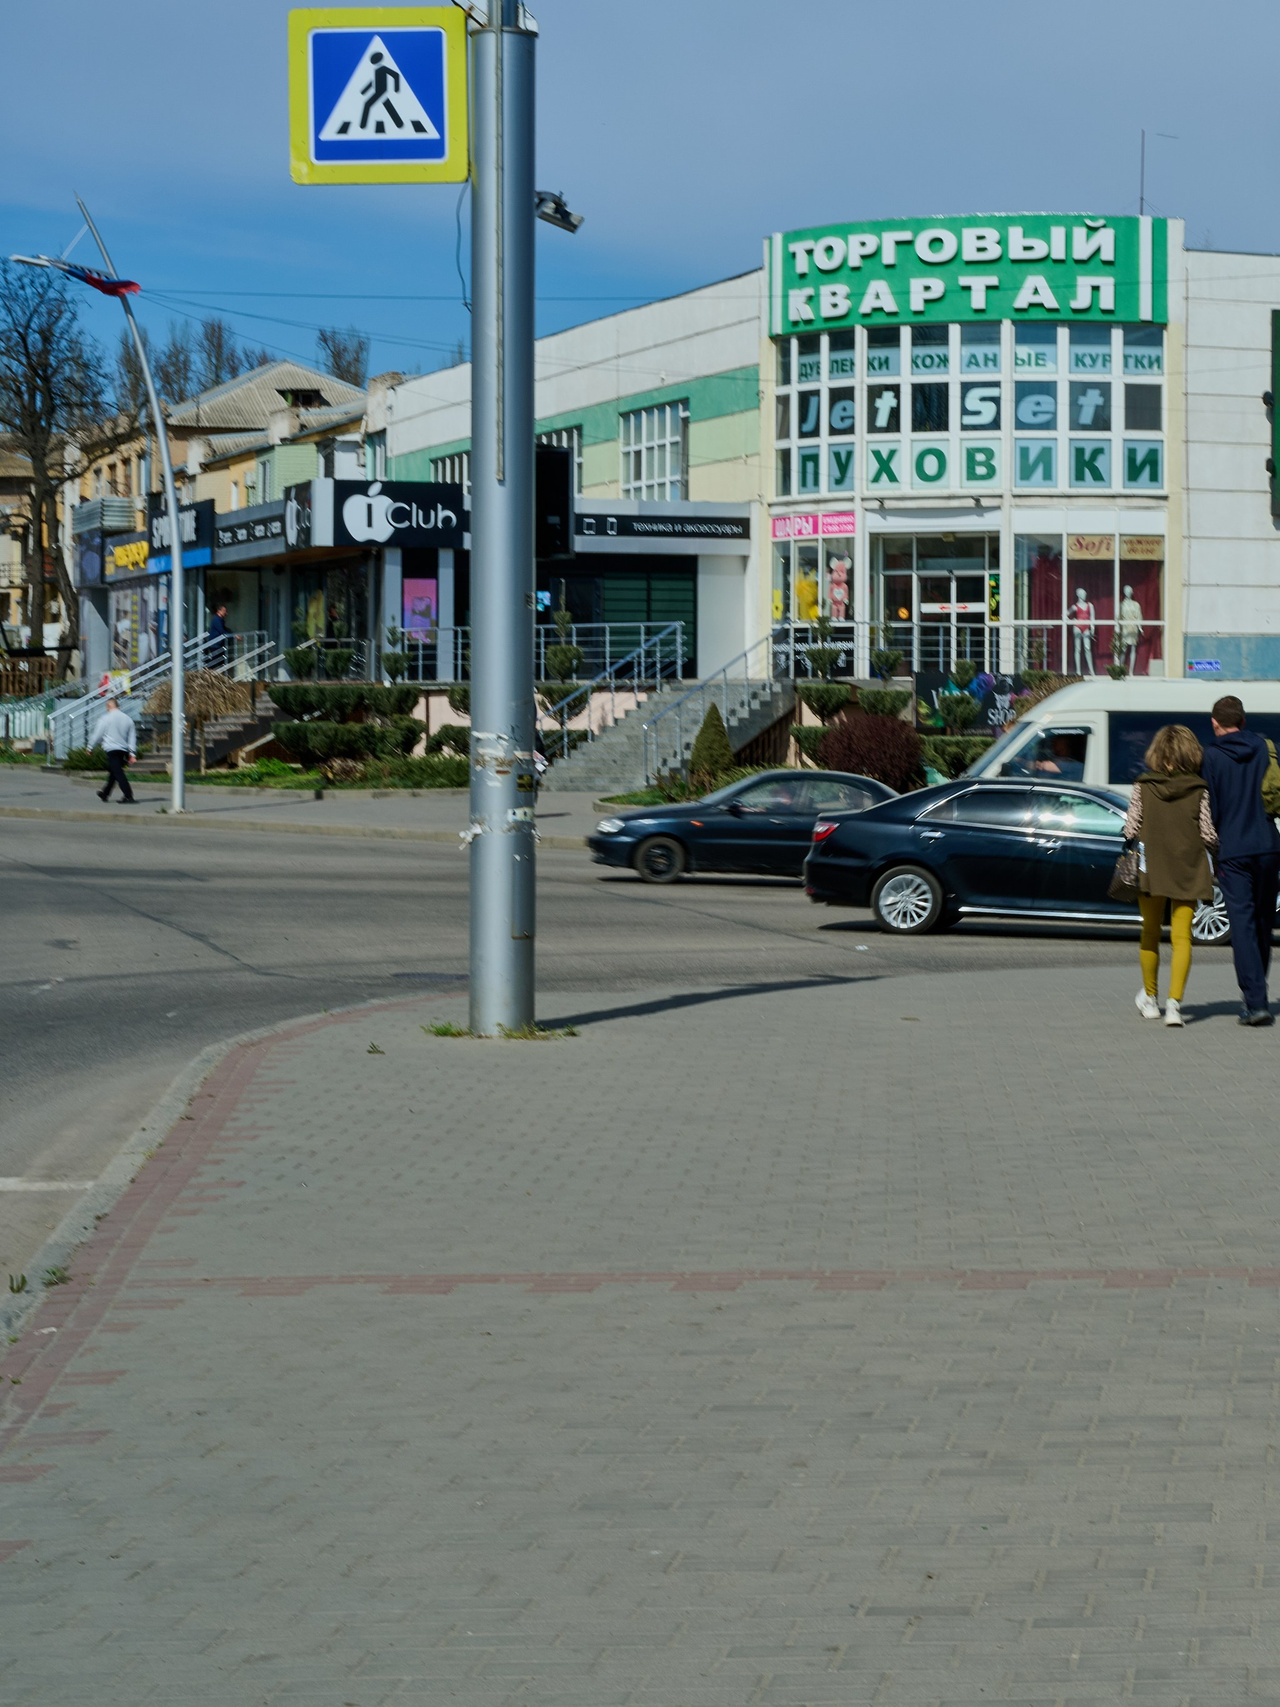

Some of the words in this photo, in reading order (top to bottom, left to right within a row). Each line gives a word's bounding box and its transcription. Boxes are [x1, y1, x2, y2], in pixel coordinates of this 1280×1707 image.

[788, 218, 1116, 276] ТОРГОВЫЙ
[787, 274, 1116, 324] КВАРТАЛ
[800, 446, 1159, 488] ПУХОВИКИ
[1068, 536, 1113, 556] Sofi
